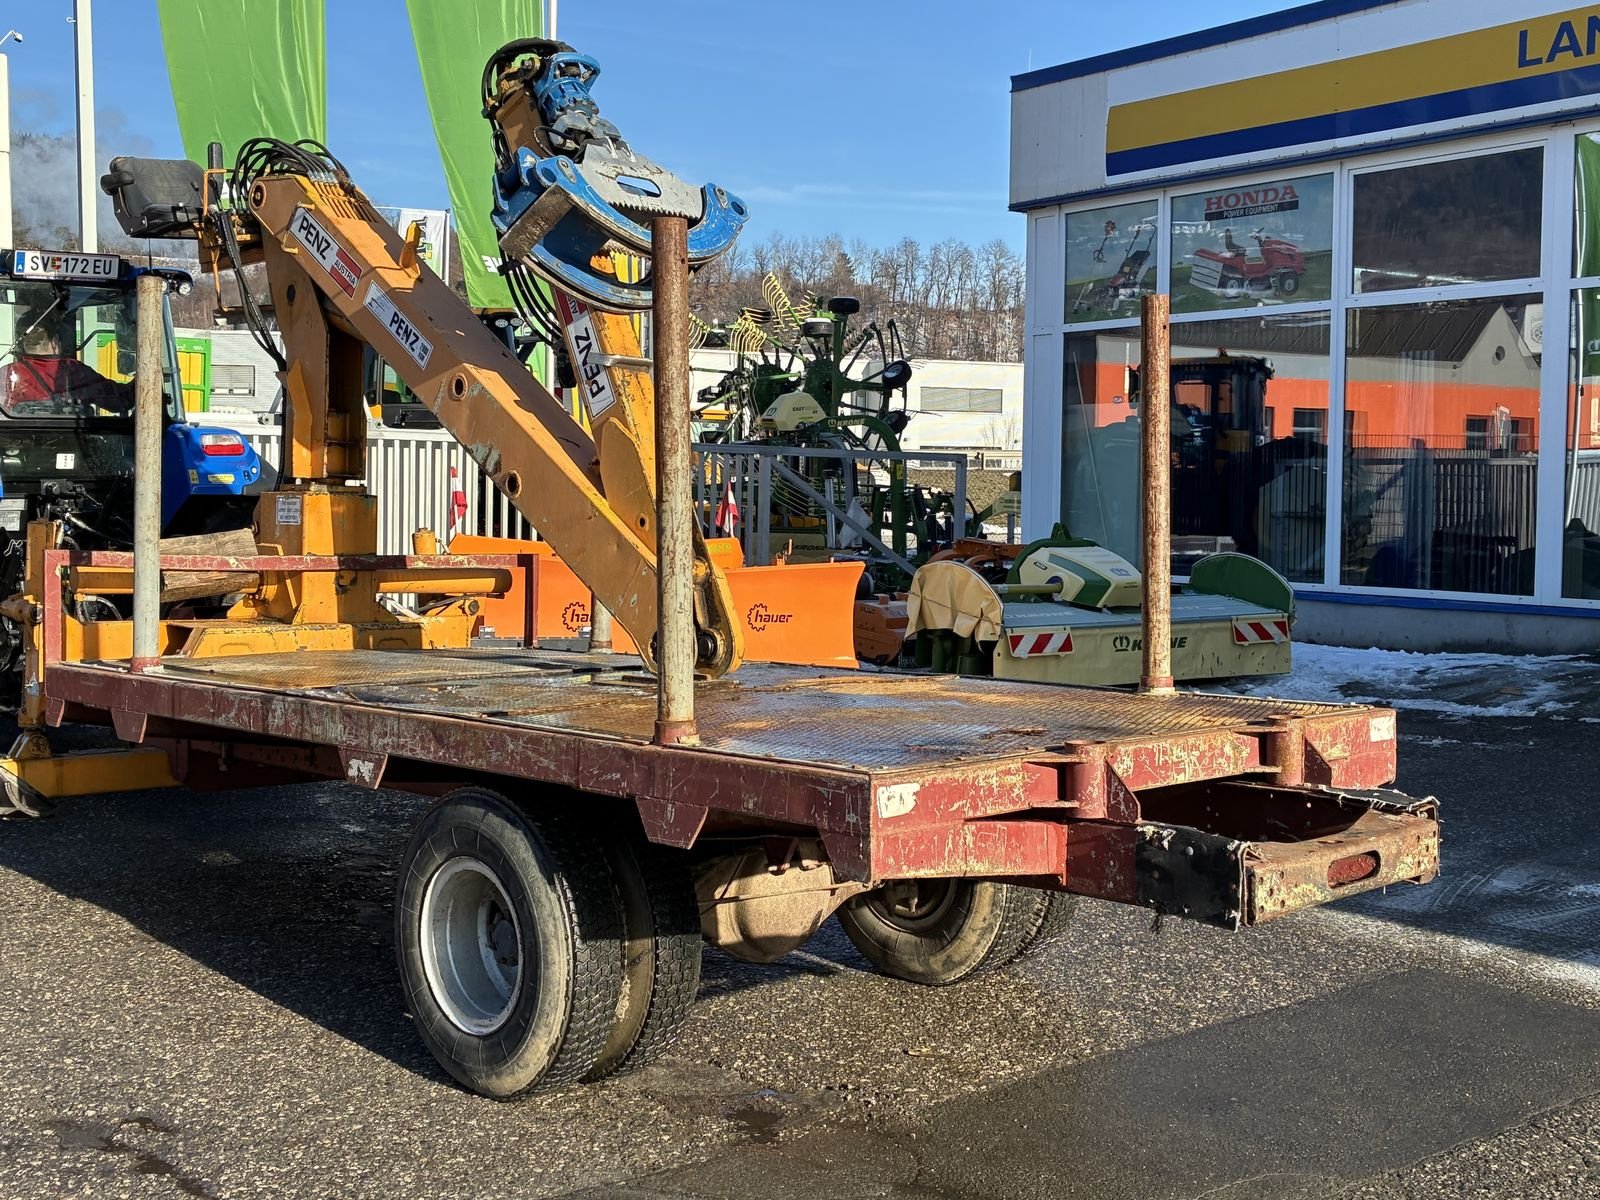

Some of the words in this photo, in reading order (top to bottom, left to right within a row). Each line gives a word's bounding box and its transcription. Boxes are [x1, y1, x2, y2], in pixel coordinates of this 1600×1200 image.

[1204, 184, 1299, 212] HONDA
[1223, 208, 1245, 218] POWER
[1246, 203, 1279, 215] EQUIPMENT
[297, 215, 332, 261] PENZ
[30, 255, 50, 272] SV
[63, 257, 89, 274] 172
[93, 259, 113, 275] EU
[333, 259, 357, 286] AUSTRIA
[388, 311, 420, 352] PENZ
[574, 326, 606, 399] PENZ
[837, 418, 866, 428] KRONE
[755, 606, 793, 624] hauer
[1131, 636, 1188, 651] KNE
